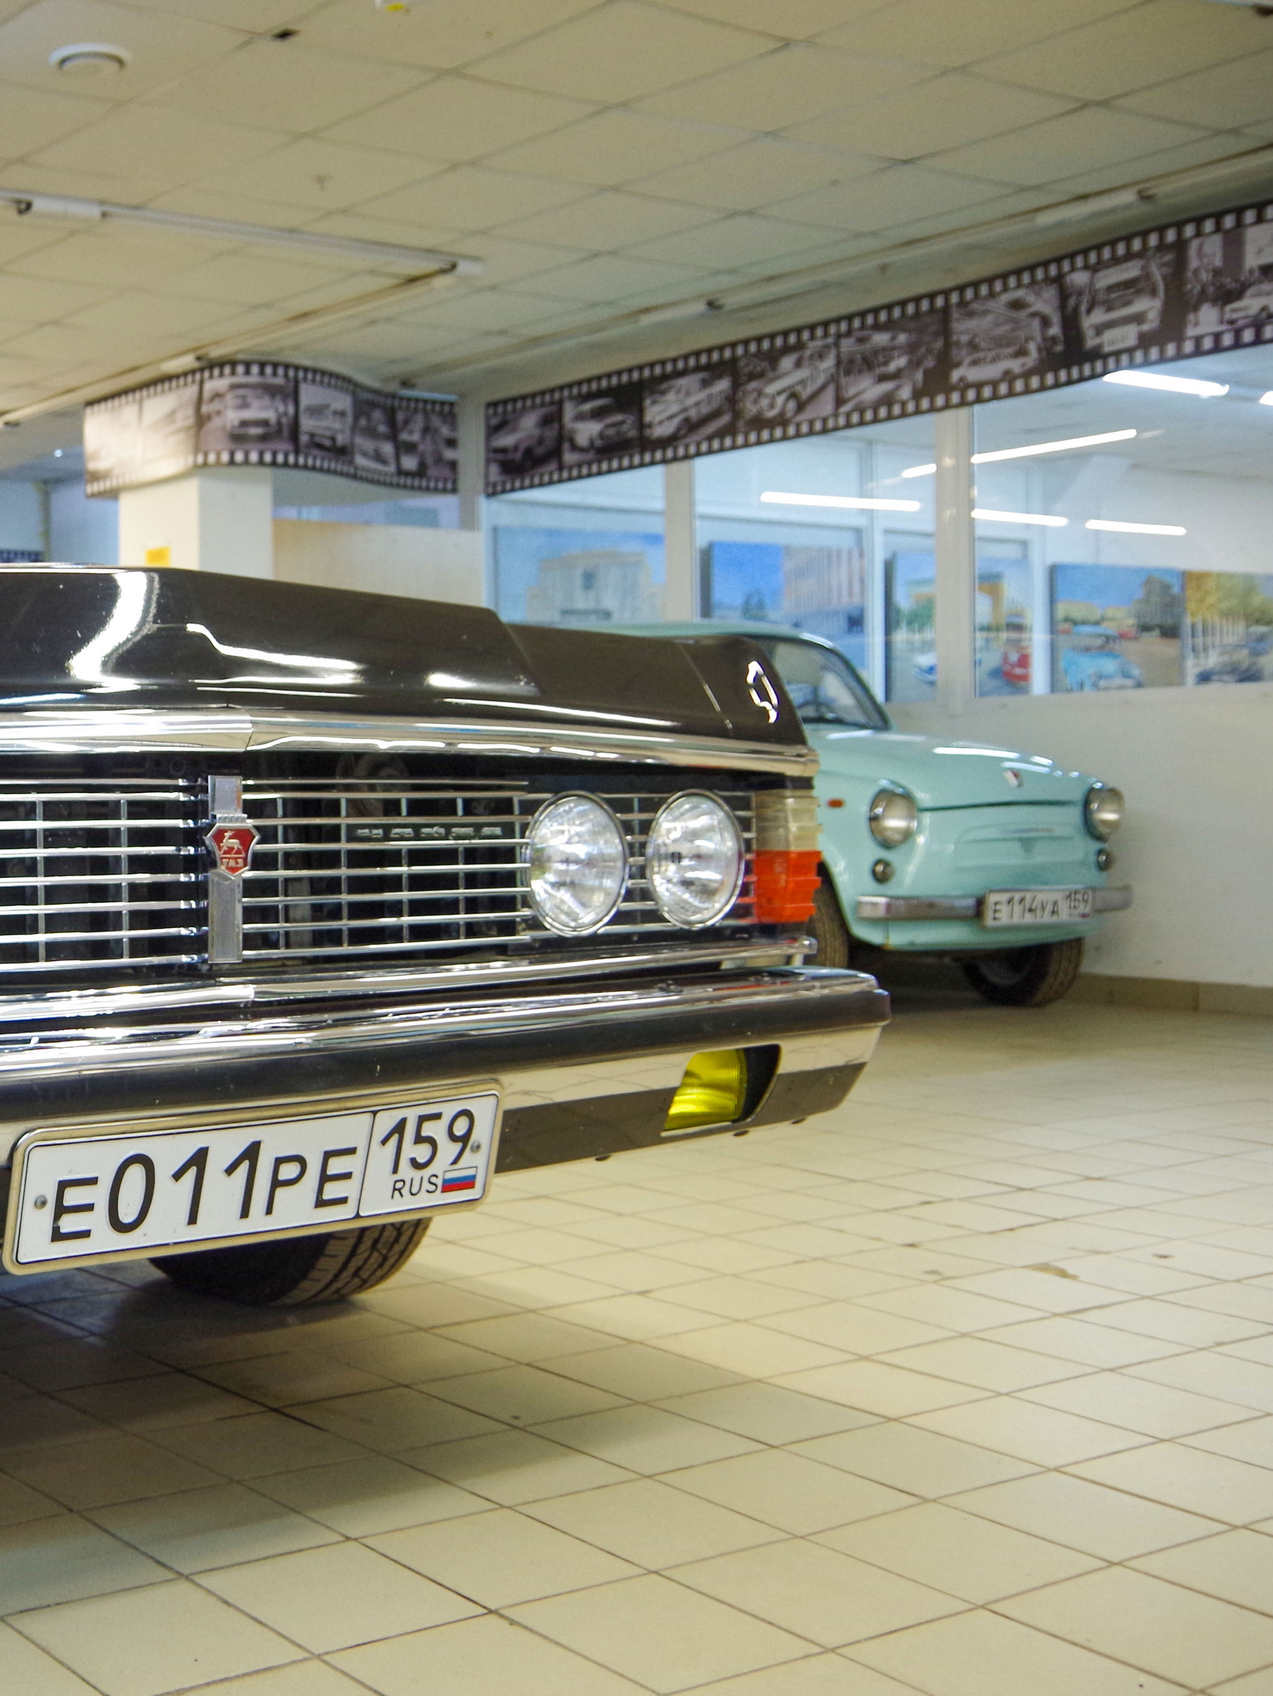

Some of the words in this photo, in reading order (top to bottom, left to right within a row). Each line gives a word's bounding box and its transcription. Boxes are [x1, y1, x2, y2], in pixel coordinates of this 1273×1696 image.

[221, 858, 244, 867] ГАЗ
[1066, 889, 1090, 910] 159
[50, 1140, 358, 1244] Е011РЕ
[379, 1108, 475, 1175] 159
[391, 1174, 439, 1200] RUS
